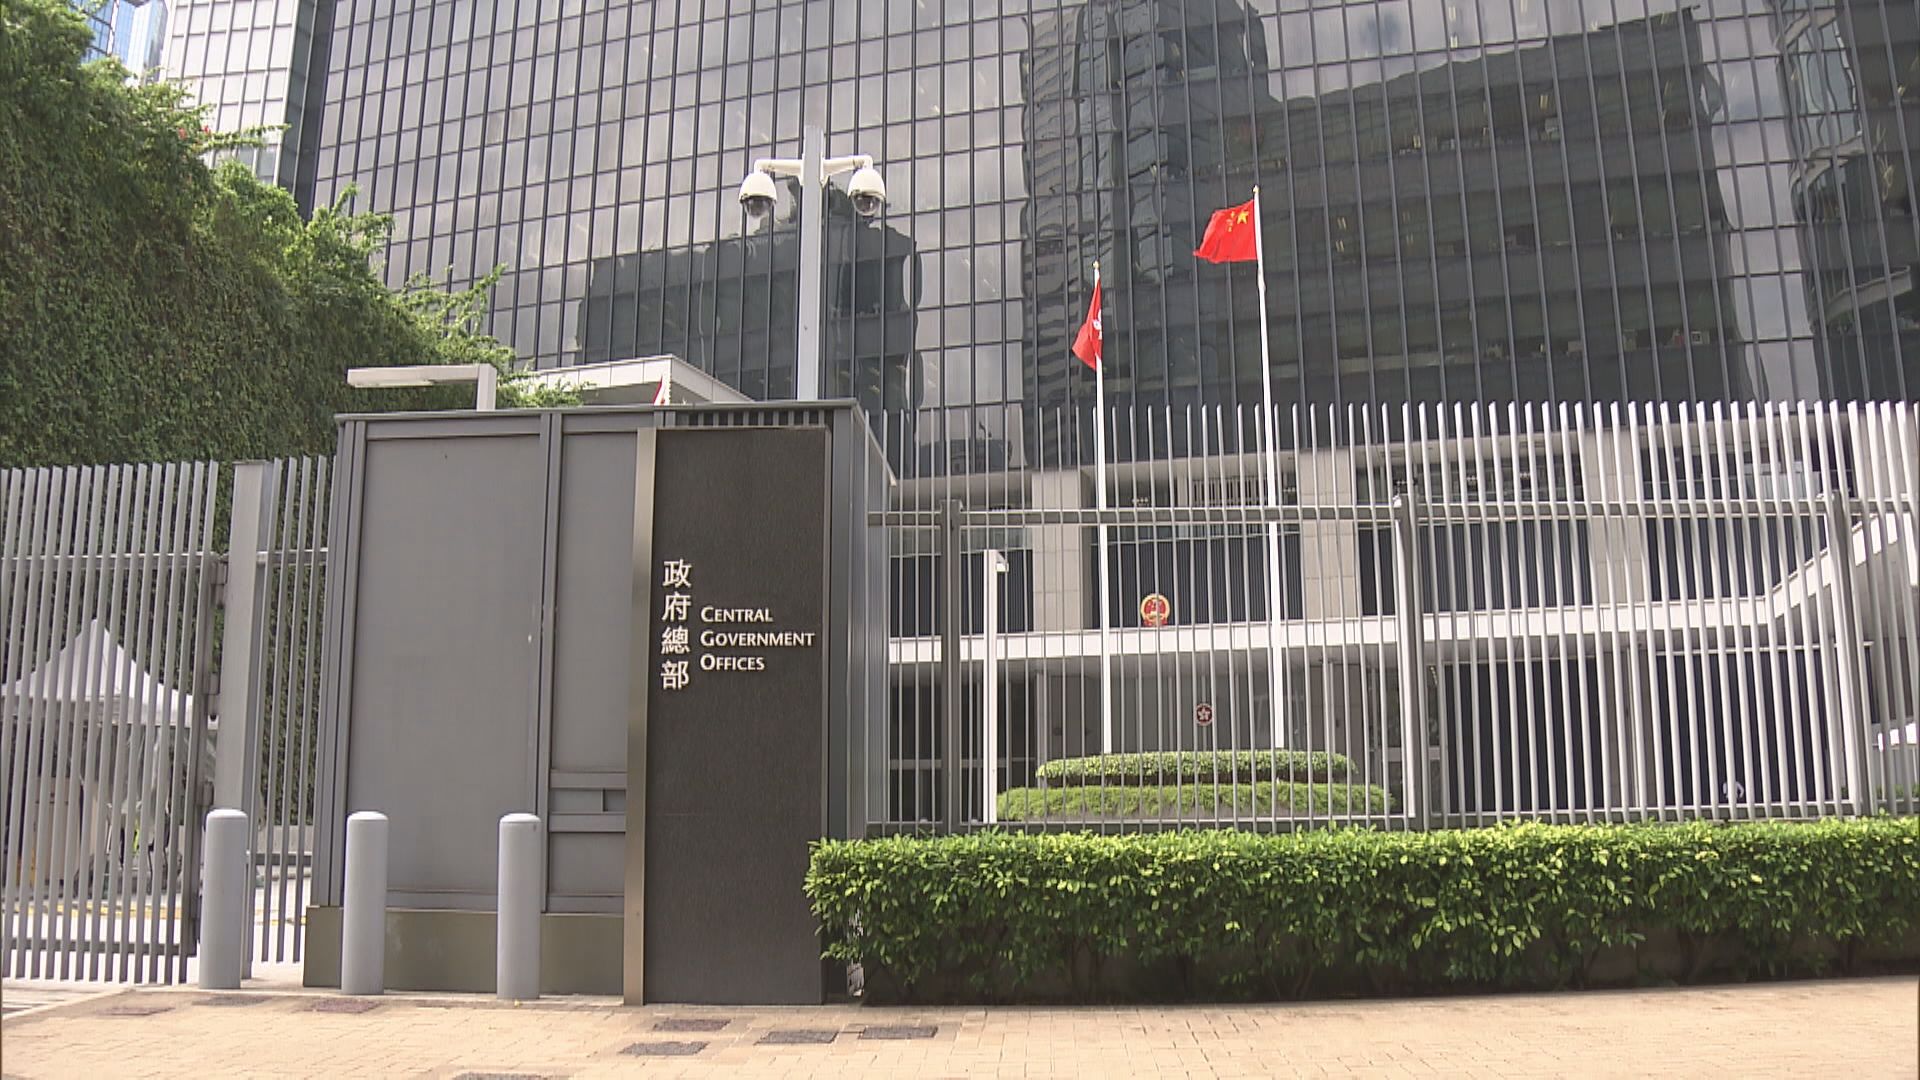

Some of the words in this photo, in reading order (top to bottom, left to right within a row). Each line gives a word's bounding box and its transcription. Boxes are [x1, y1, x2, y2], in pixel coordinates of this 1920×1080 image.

[700, 605, 774, 623] CENTRAL
[660, 558, 693, 690] 政府總部
[700, 629, 816, 647] GOVERNMENT
[700, 653, 766, 671] OFFICES
